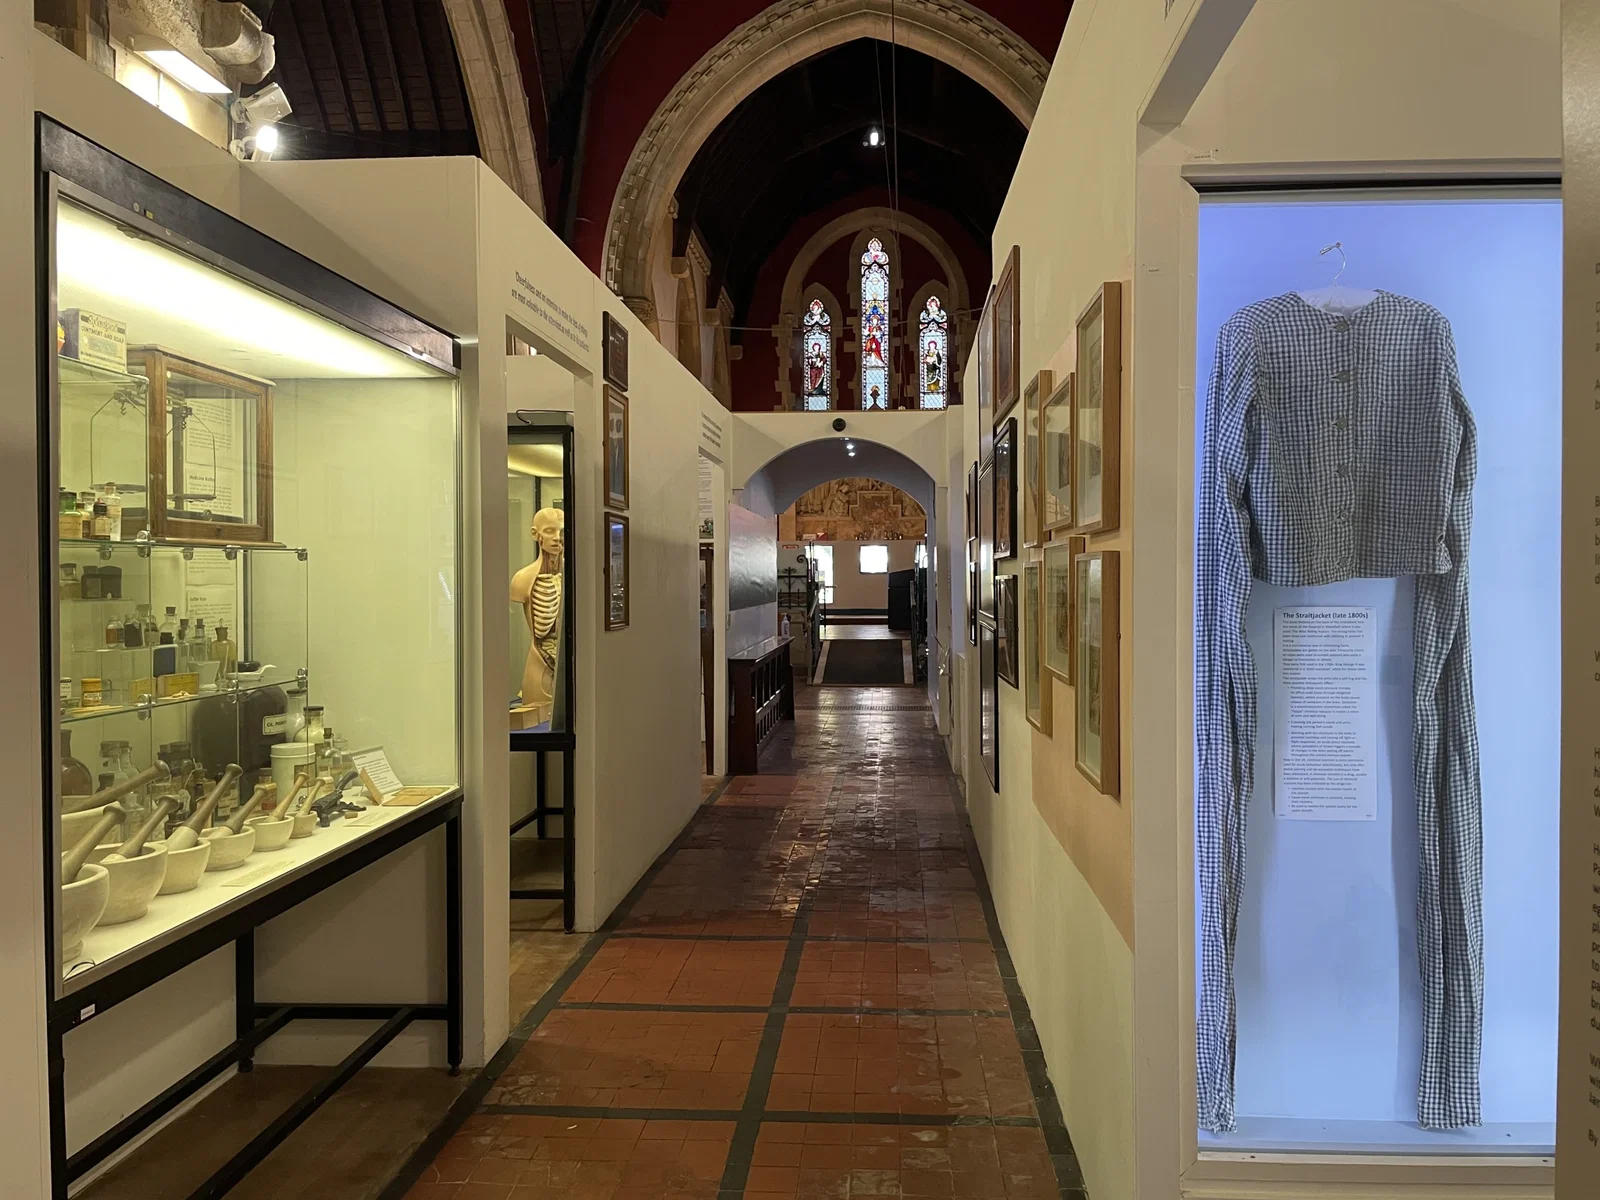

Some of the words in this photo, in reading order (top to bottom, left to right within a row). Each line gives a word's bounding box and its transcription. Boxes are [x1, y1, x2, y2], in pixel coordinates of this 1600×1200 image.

[1295, 612, 1331, 620] Straitjacket
[1332, 612, 1347, 620] (late
[1348, 612, 1369, 620] 1800s)
